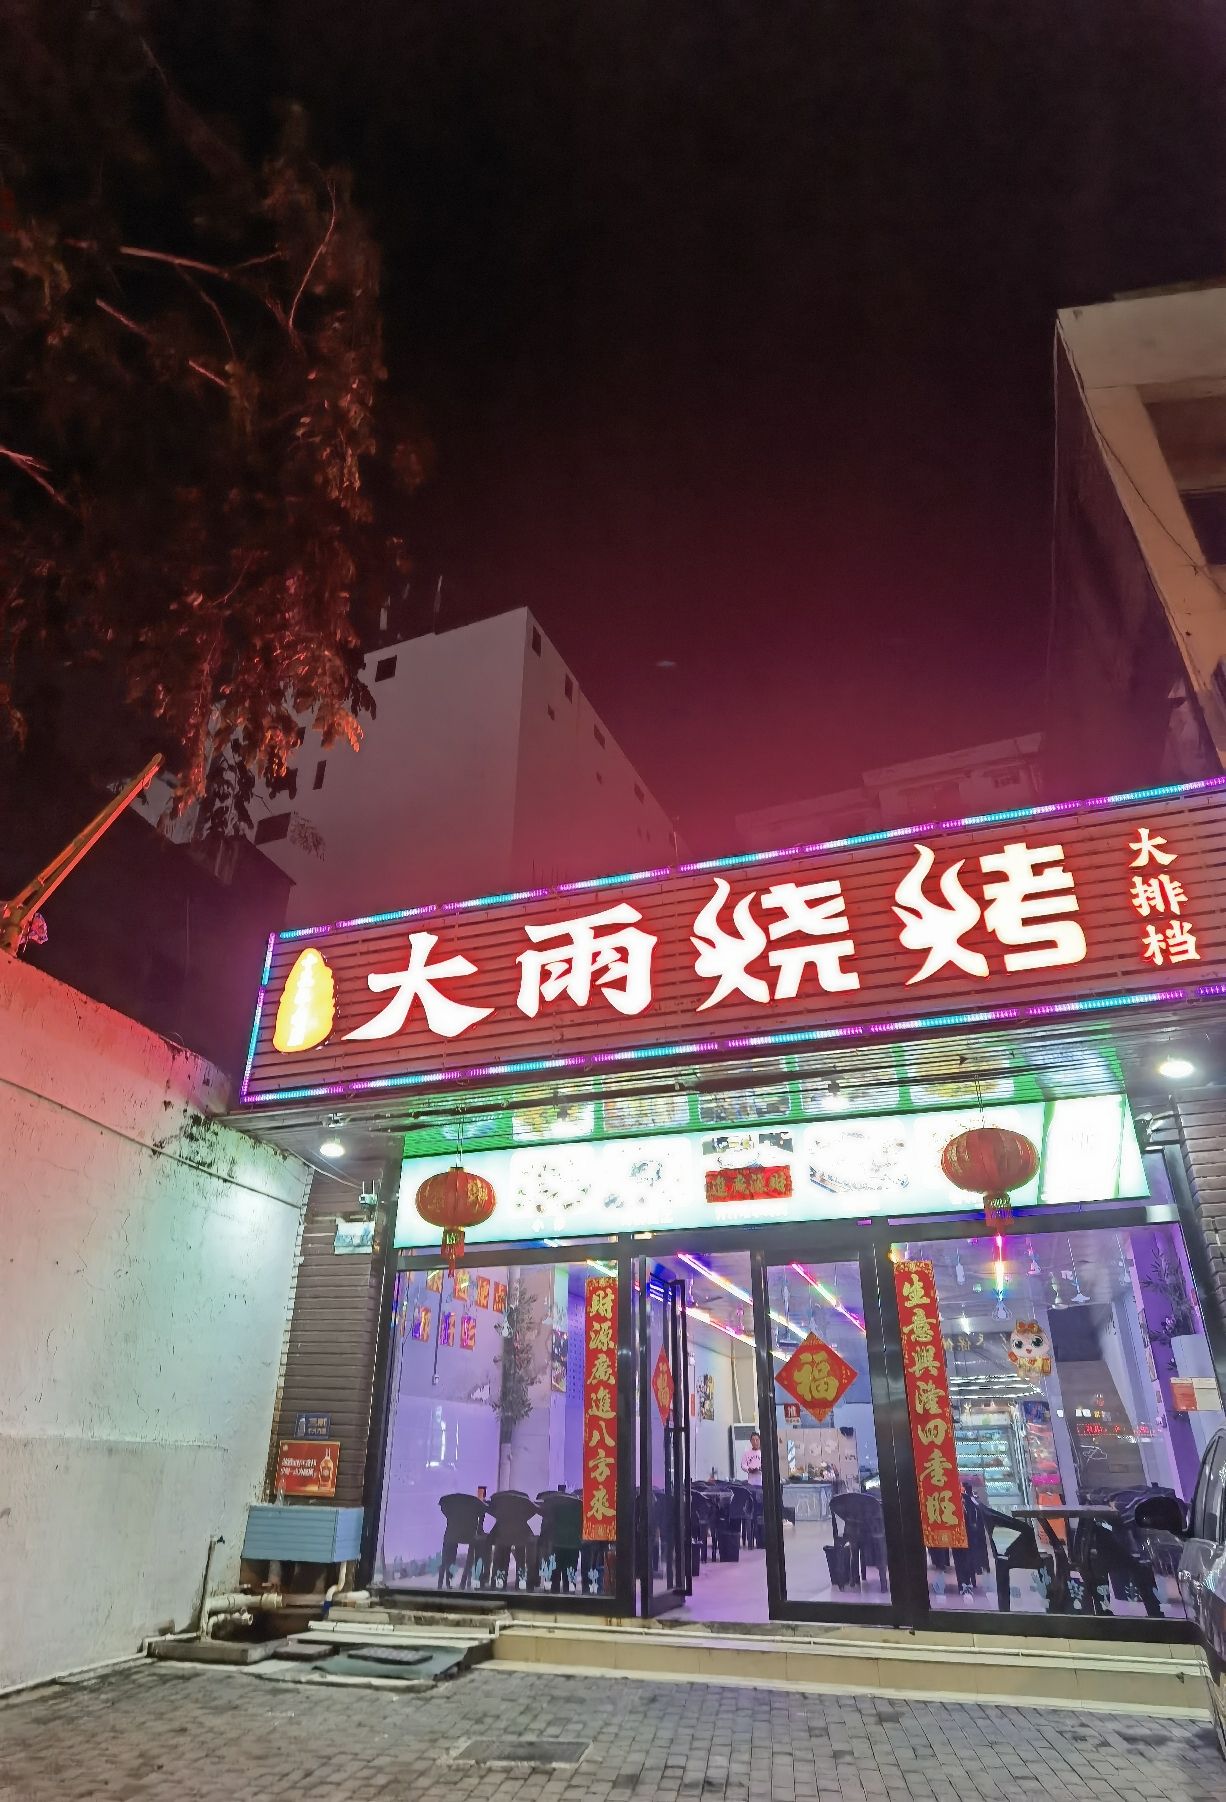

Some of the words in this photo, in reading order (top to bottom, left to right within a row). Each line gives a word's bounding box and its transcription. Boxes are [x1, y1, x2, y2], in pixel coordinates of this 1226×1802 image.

[343, 843, 1088, 1041] 大雨烧烤
[1129, 827, 1202, 967] 大排档
[792, 1350, 840, 1402] 福
